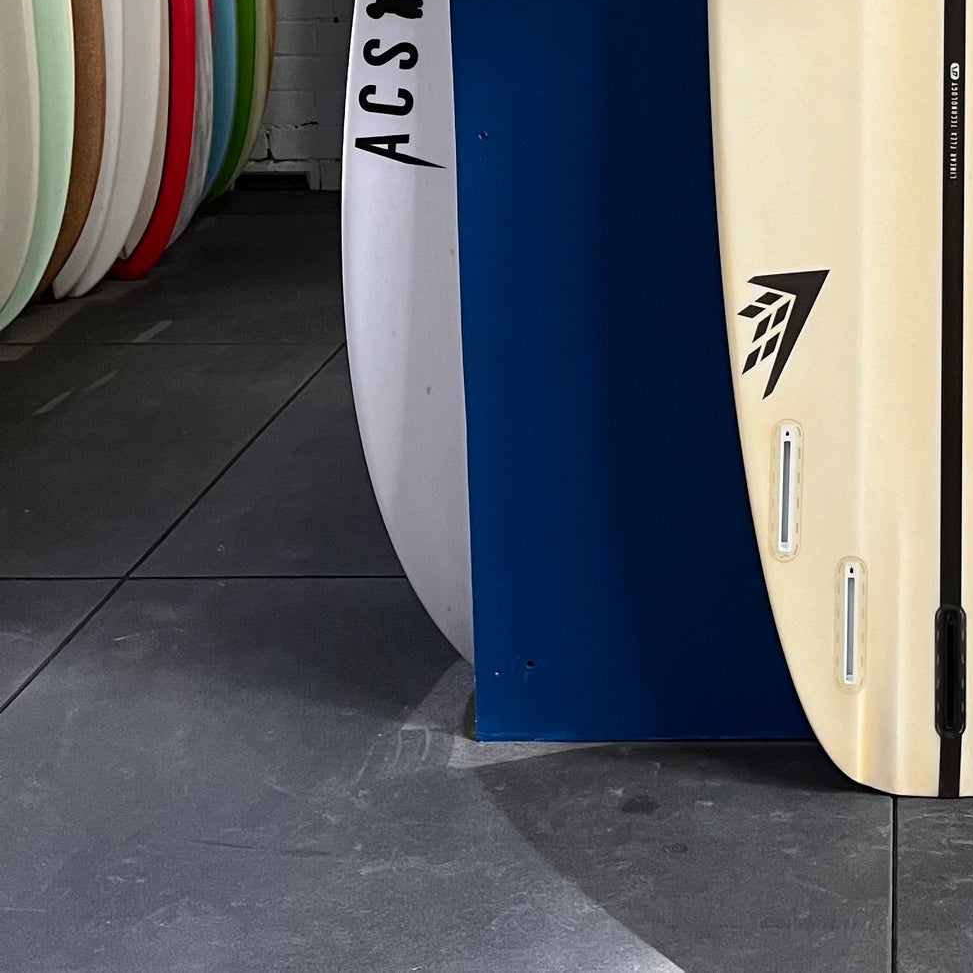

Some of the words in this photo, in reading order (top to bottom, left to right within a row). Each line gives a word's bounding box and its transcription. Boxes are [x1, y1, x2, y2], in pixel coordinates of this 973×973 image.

[950, 82, 959, 128] TECHNOLOGY
[949, 132, 958, 150] FLEX
[949, 153, 958, 180] LINEAR
